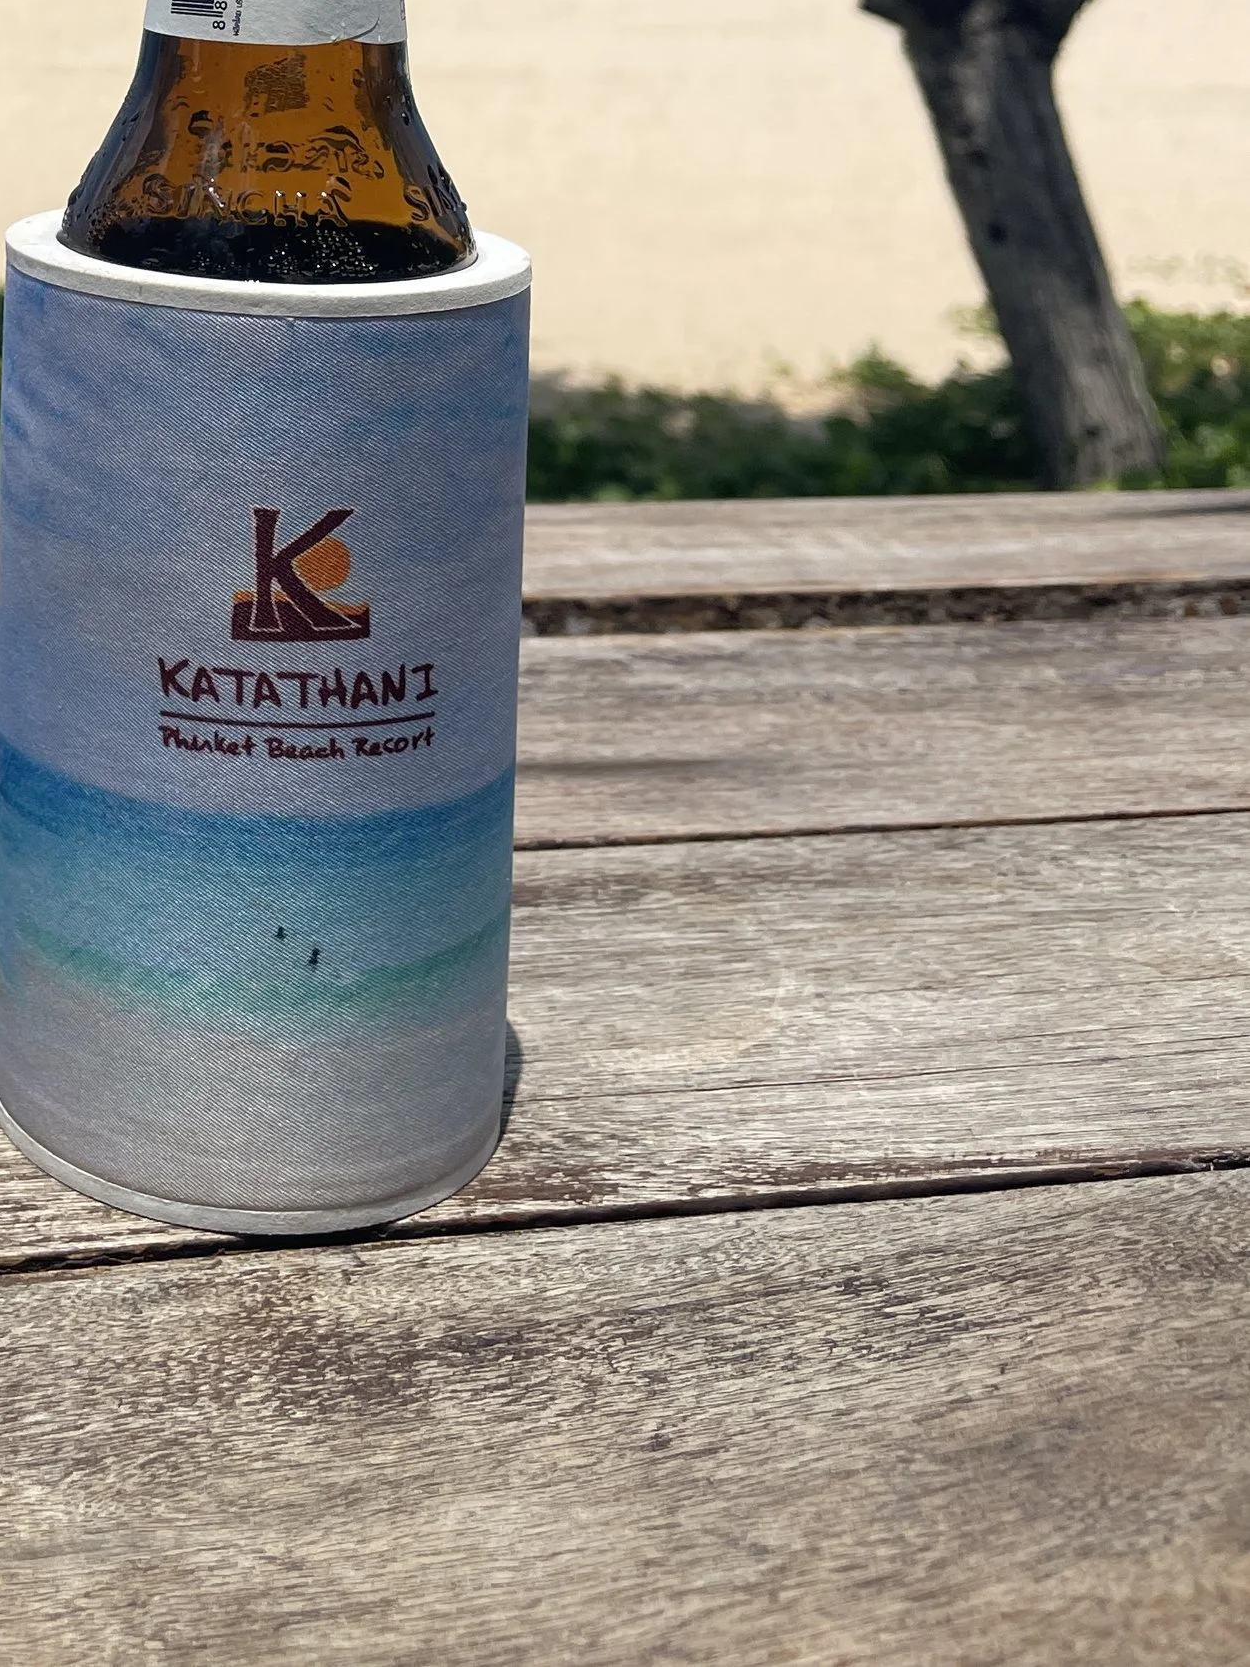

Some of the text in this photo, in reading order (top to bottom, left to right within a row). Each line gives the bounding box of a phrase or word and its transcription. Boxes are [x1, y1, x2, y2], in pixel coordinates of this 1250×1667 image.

[212, 20, 226, 30] 8
[158, 656, 439, 709] KATATHANI
[266, 737, 346, 760] Beach
